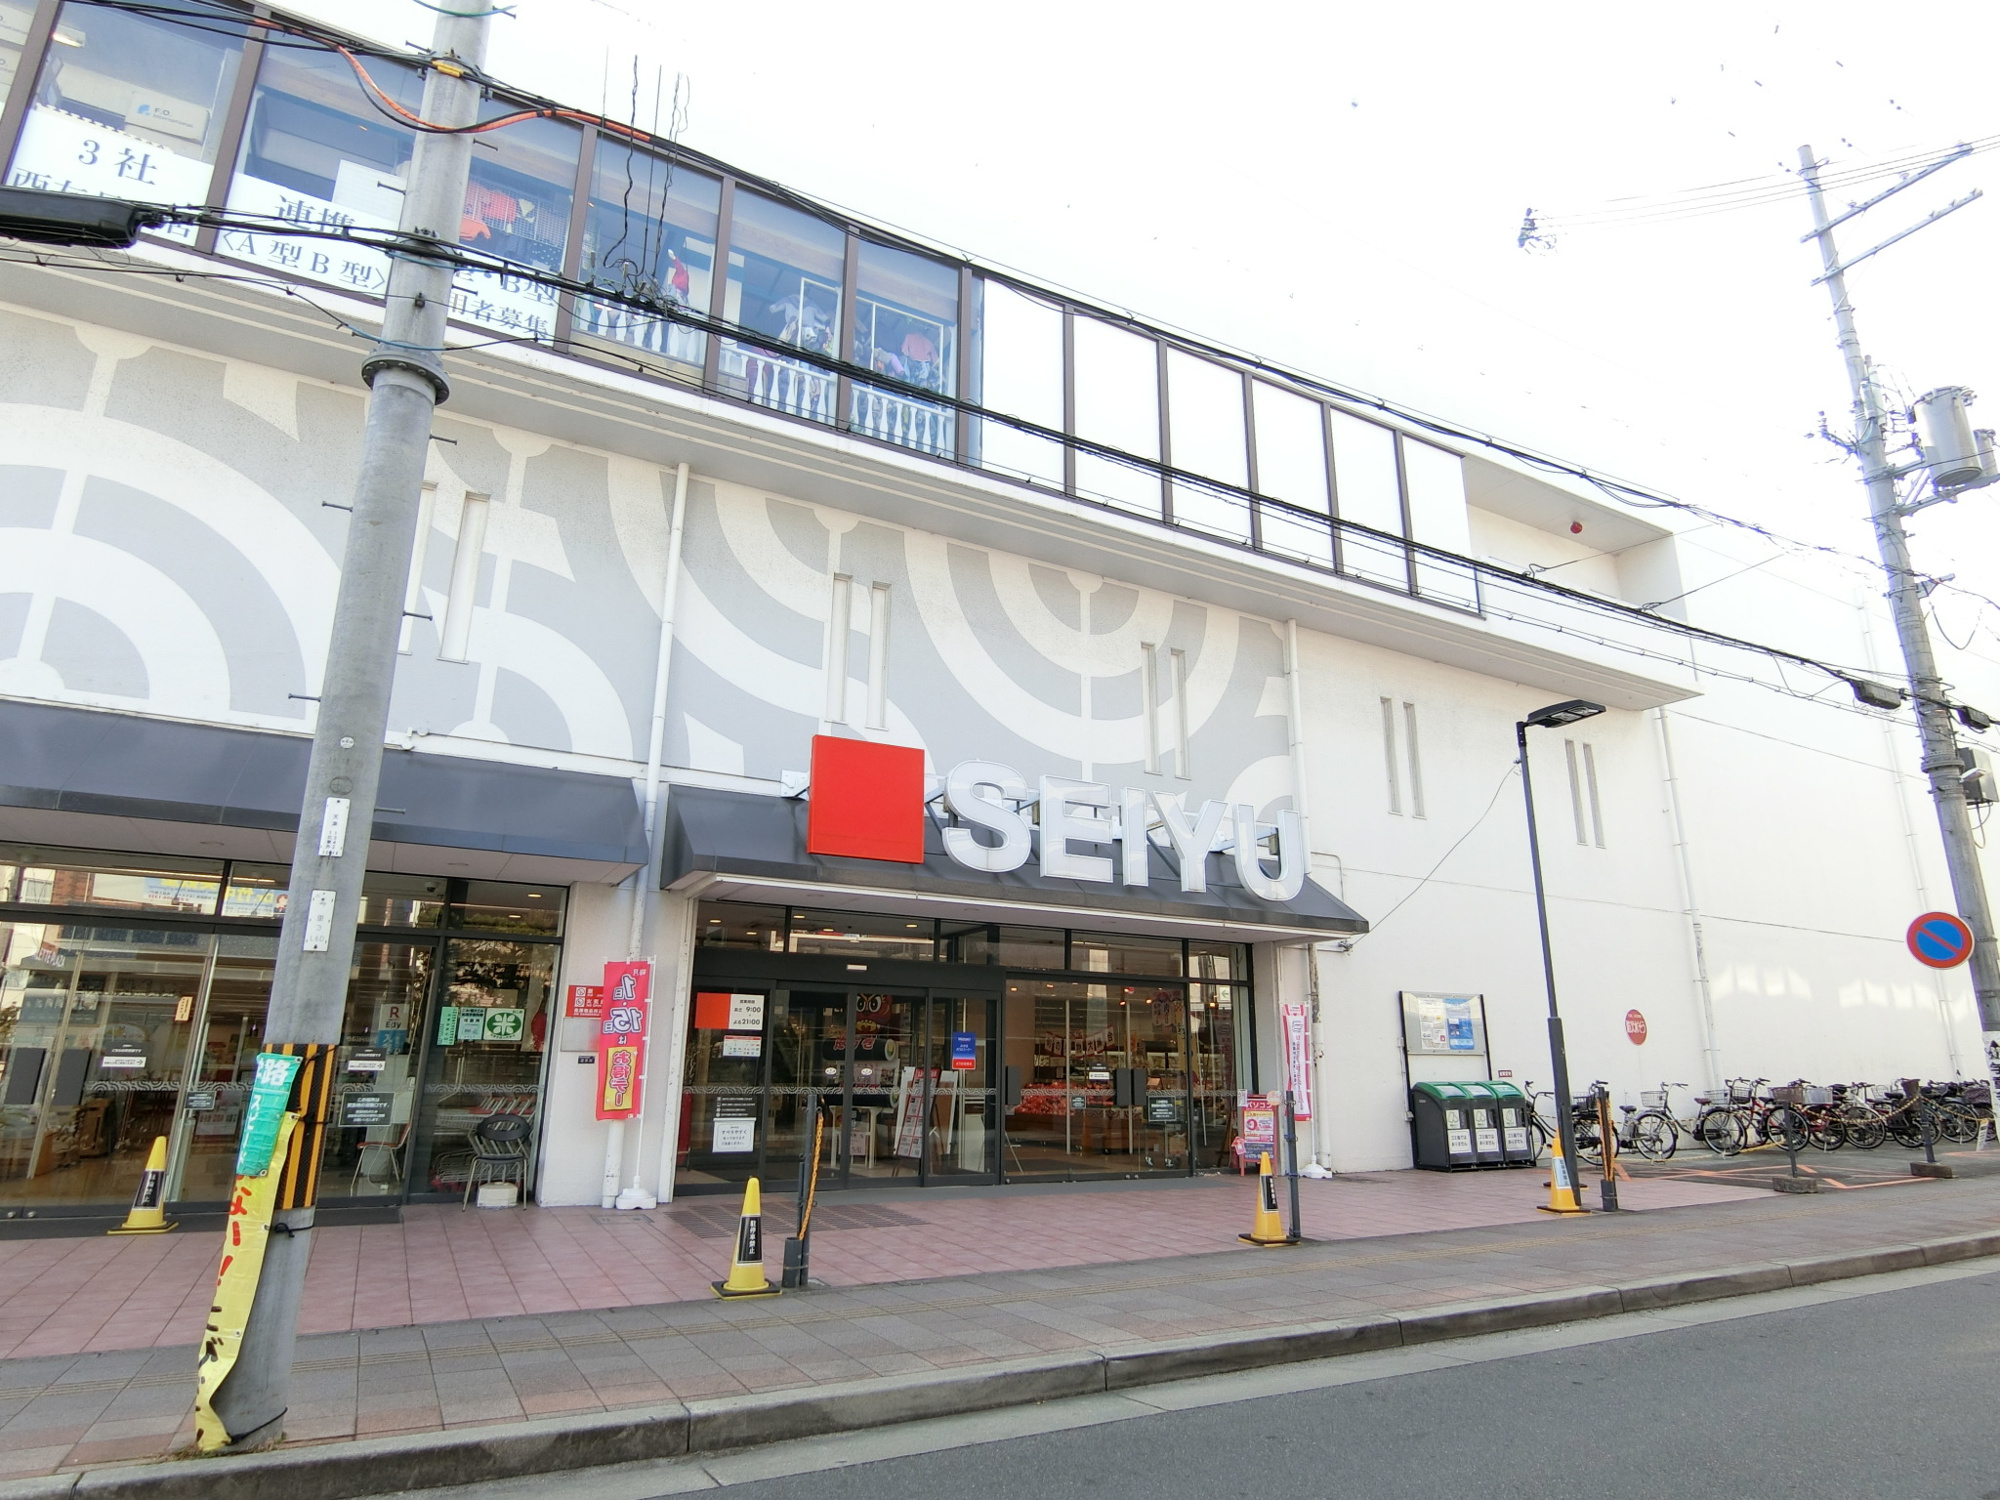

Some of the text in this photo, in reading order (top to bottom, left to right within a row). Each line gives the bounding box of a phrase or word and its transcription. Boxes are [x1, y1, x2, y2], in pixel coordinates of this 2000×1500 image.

[941, 758, 1305, 902] SEIYU
[385, 1020, 402, 1029] Edy
[742, 1018, 761, 1026] 21:00
[258, 1058, 290, 1086] 路
